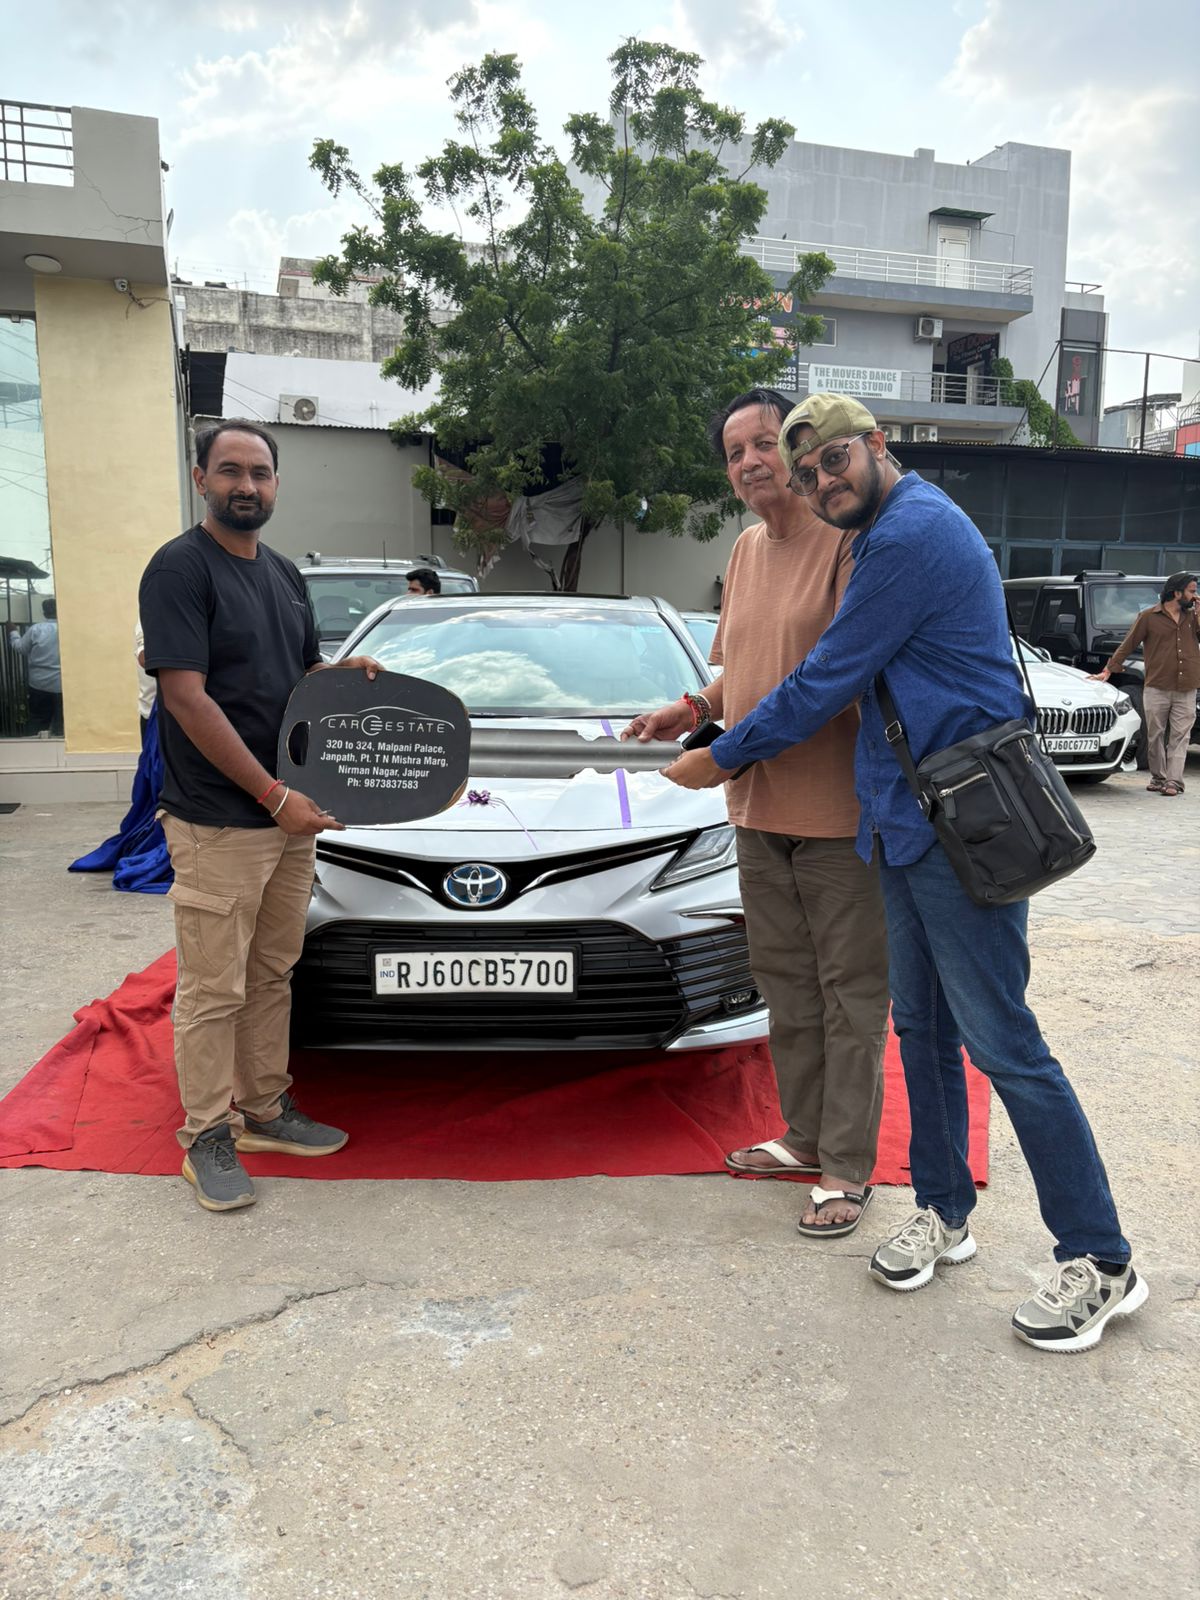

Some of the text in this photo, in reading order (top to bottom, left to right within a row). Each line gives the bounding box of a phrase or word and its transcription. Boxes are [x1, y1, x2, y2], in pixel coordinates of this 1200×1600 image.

[814, 367, 897, 382] THE MOVERS DANCE
[817, 379, 893, 392] & FITNESS STUDIO
[328, 718, 445, 733] CAR ESTATE
[326, 739, 446, 754] 320 to 324, Malpani Palace,
[1047, 740, 1099, 751] RJ60CG7779
[320, 751, 449, 768] Janpath, Pt. T N Mishra Marg,
[338, 765, 430, 779] Nirman Nagar, Jaipur
[347, 777, 419, 790] Ph: 9873837583
[379, 958, 568, 989] IND RJ60CB5700
